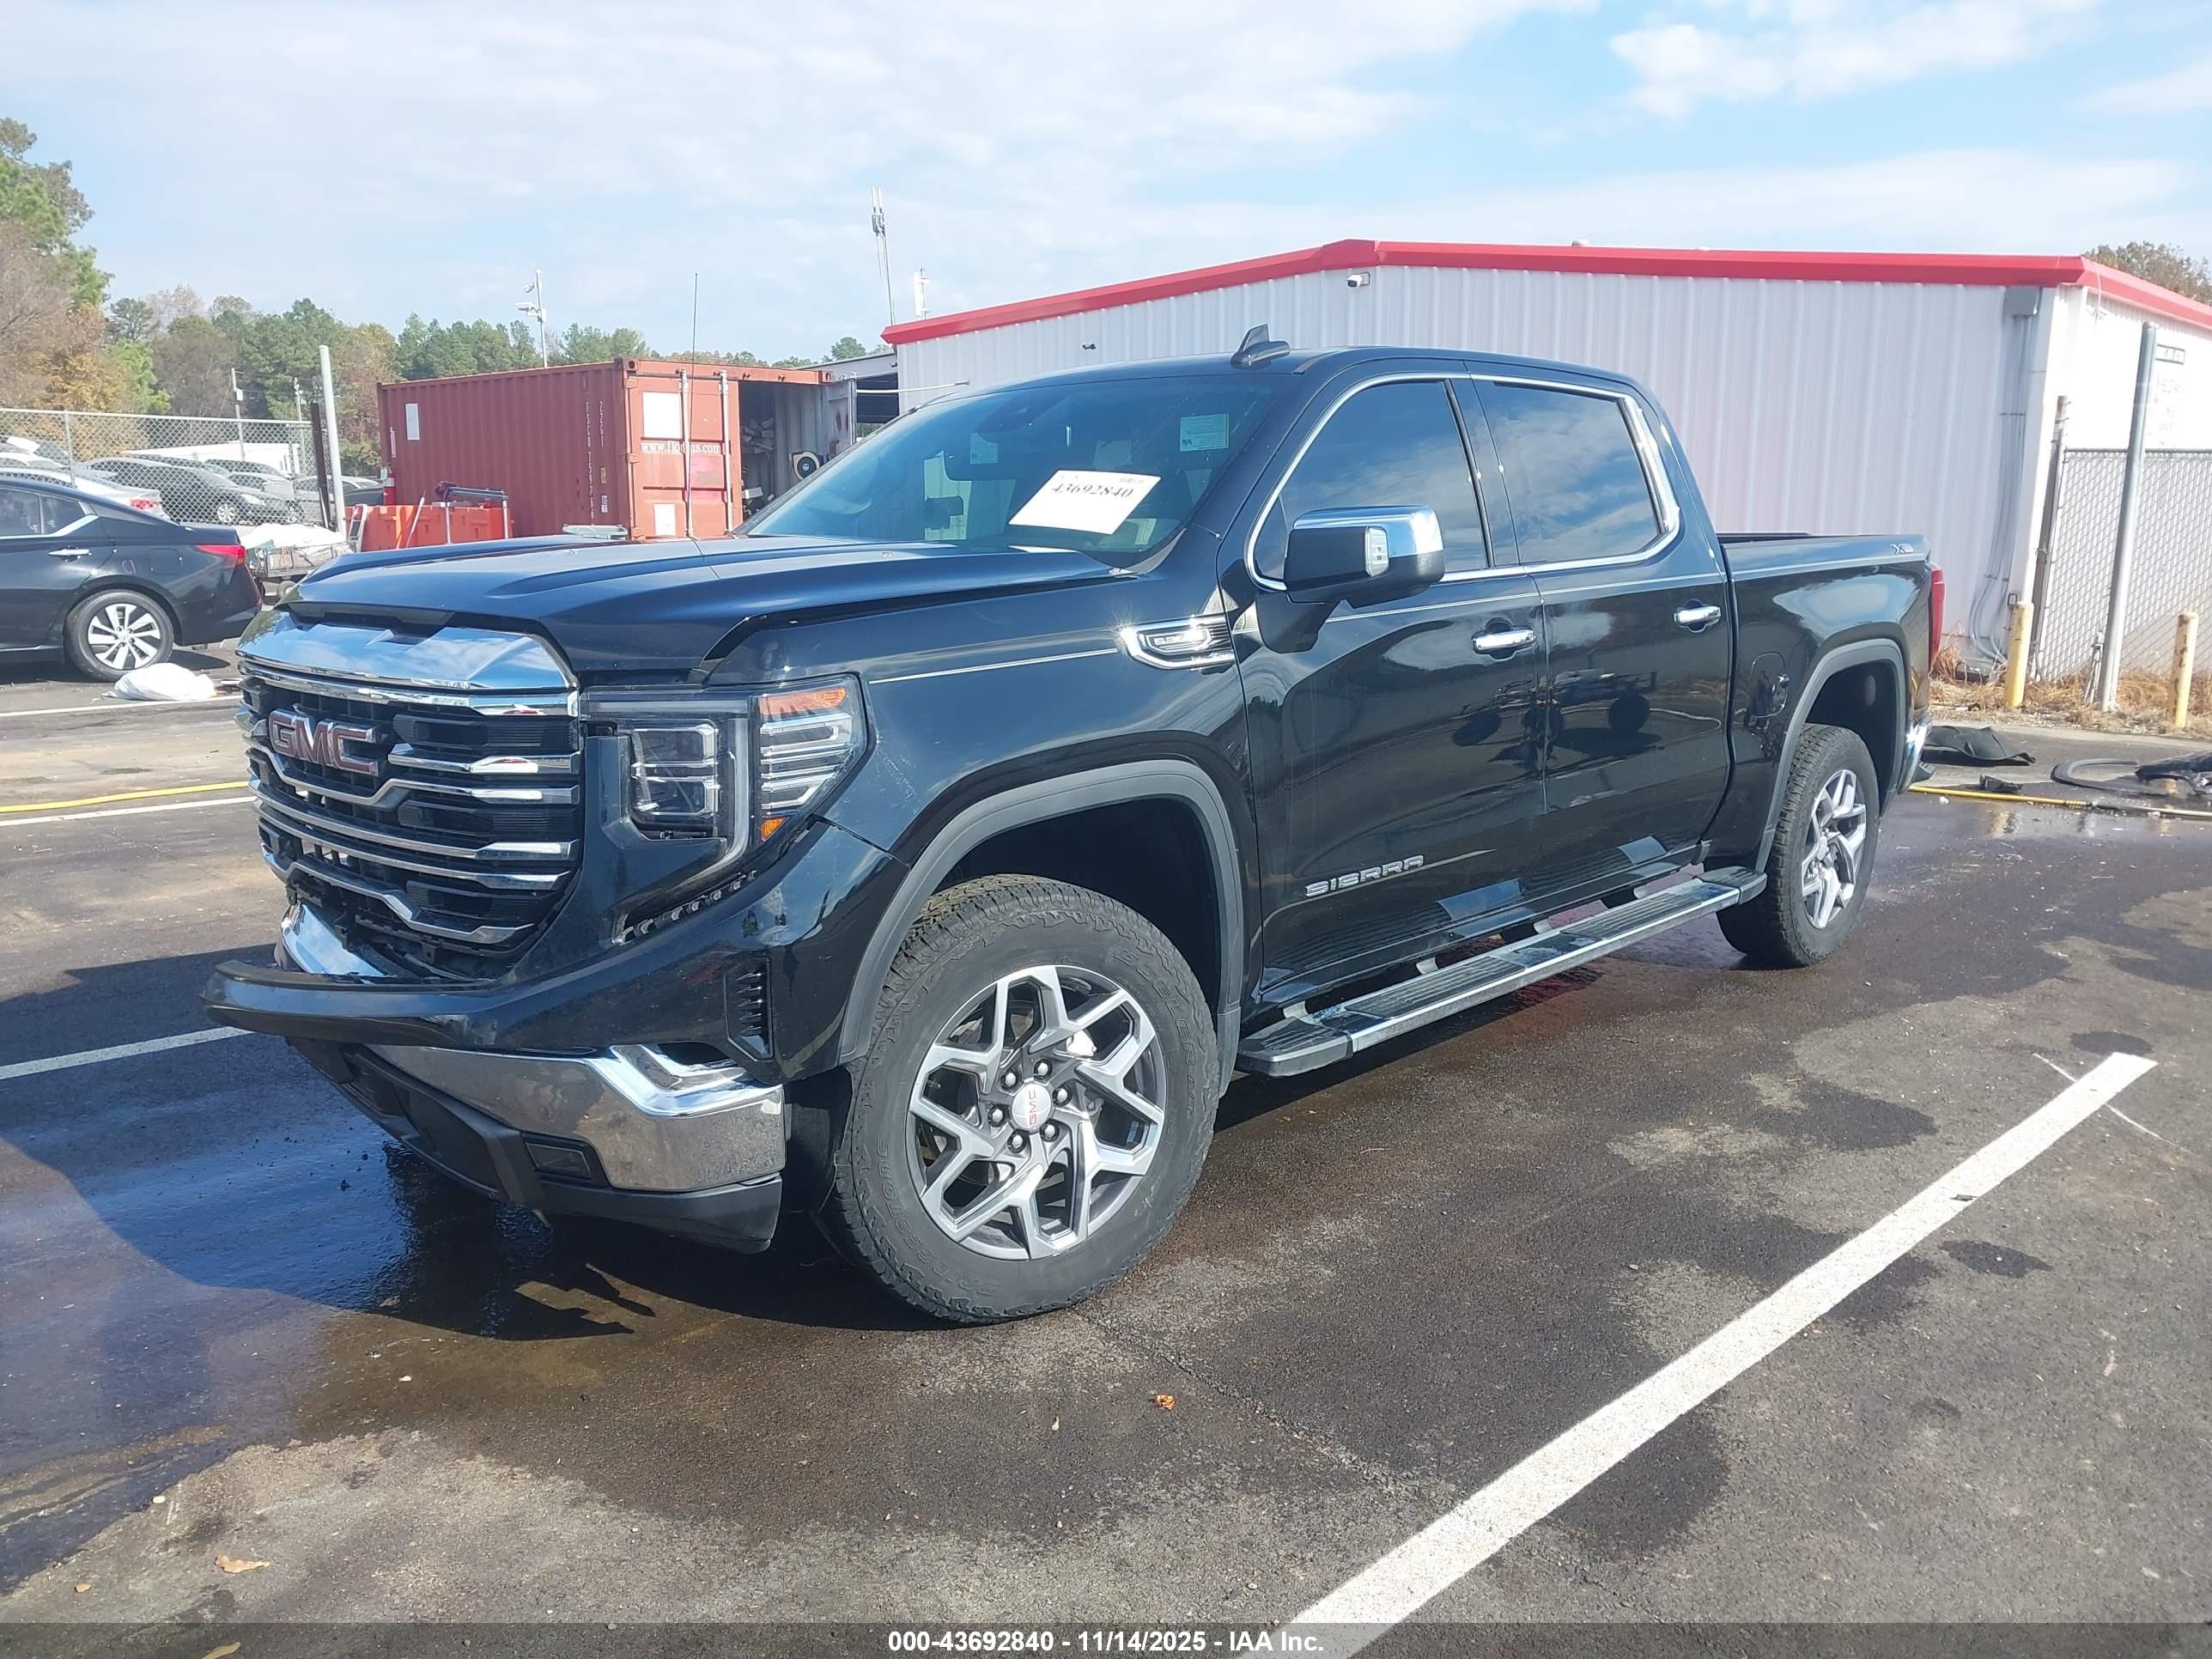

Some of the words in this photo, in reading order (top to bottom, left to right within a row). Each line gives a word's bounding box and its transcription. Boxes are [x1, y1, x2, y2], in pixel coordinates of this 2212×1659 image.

[640, 441, 721, 453] www.florns.com
[1052, 483, 1133, 497] 43692840
[269, 708, 379, 776] GMC
[1305, 854, 1425, 897] SIERRA
